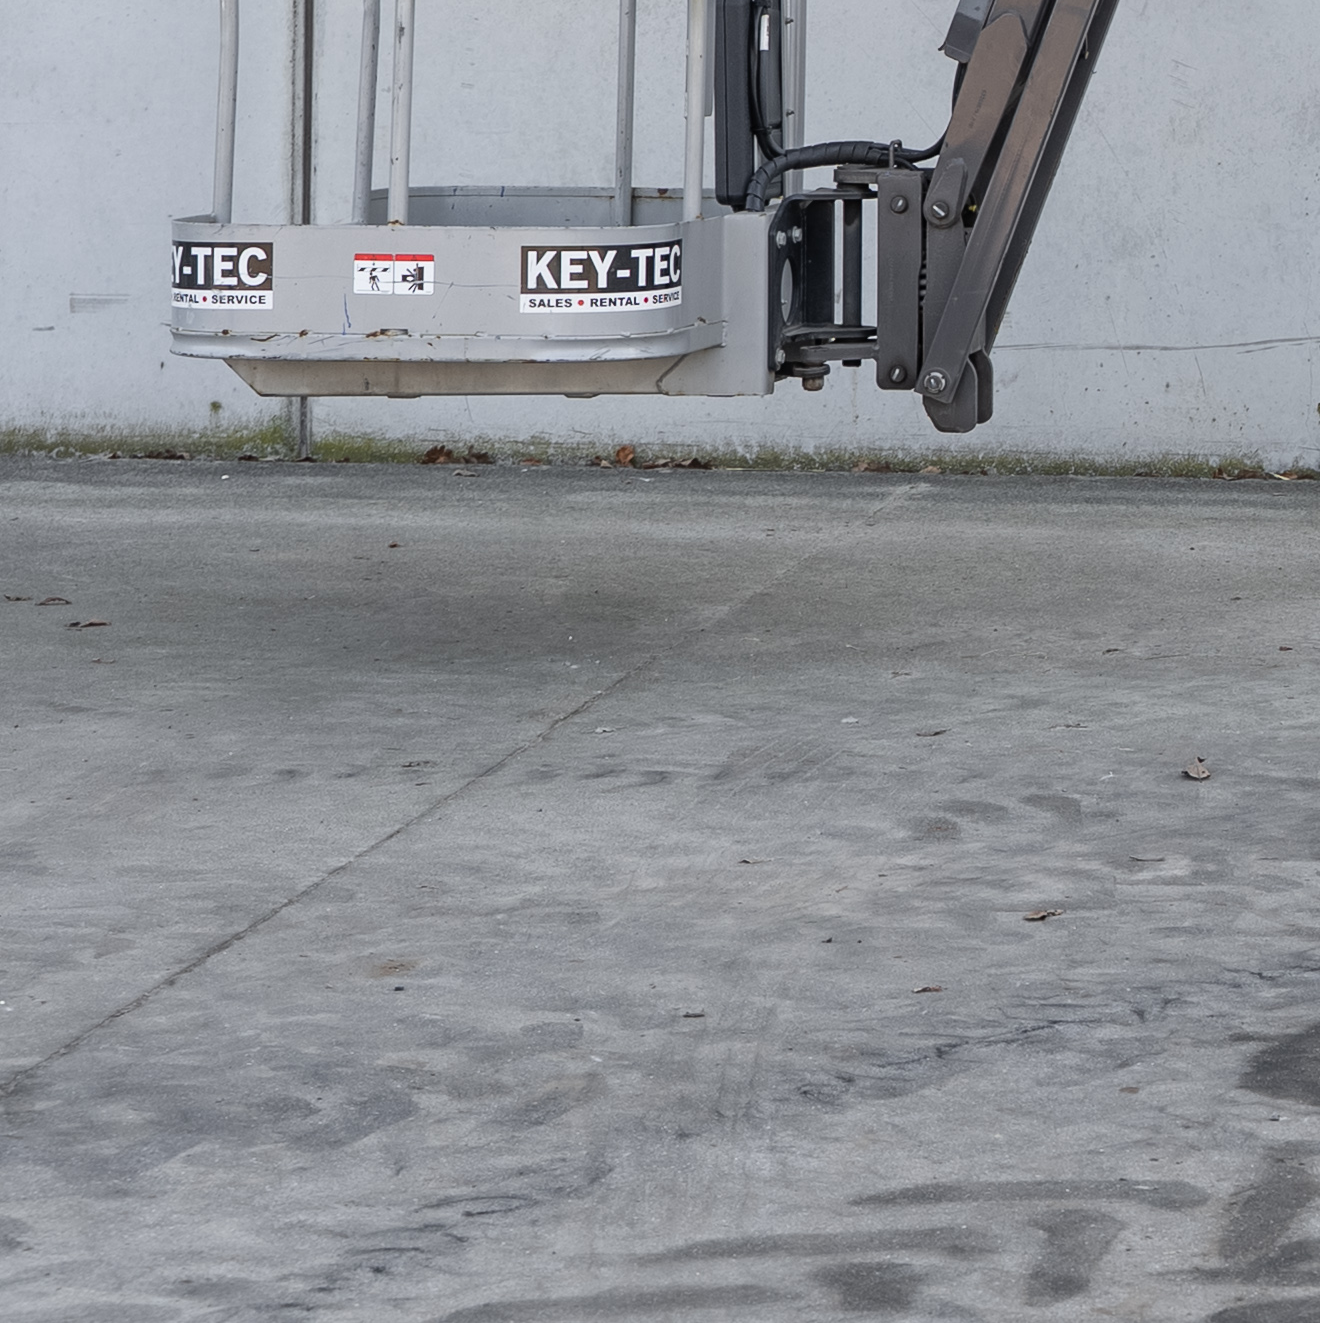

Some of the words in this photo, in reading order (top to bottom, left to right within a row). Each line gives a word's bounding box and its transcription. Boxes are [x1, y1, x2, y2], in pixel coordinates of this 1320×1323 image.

[172, 245, 268, 287] Y-TEC
[527, 244, 681, 290] KEY-TEC
[211, 294, 267, 305] SERVICE
[528, 298, 573, 308] SALES
[589, 296, 640, 308] RENTAL
[652, 290, 680, 305] SERVICE
